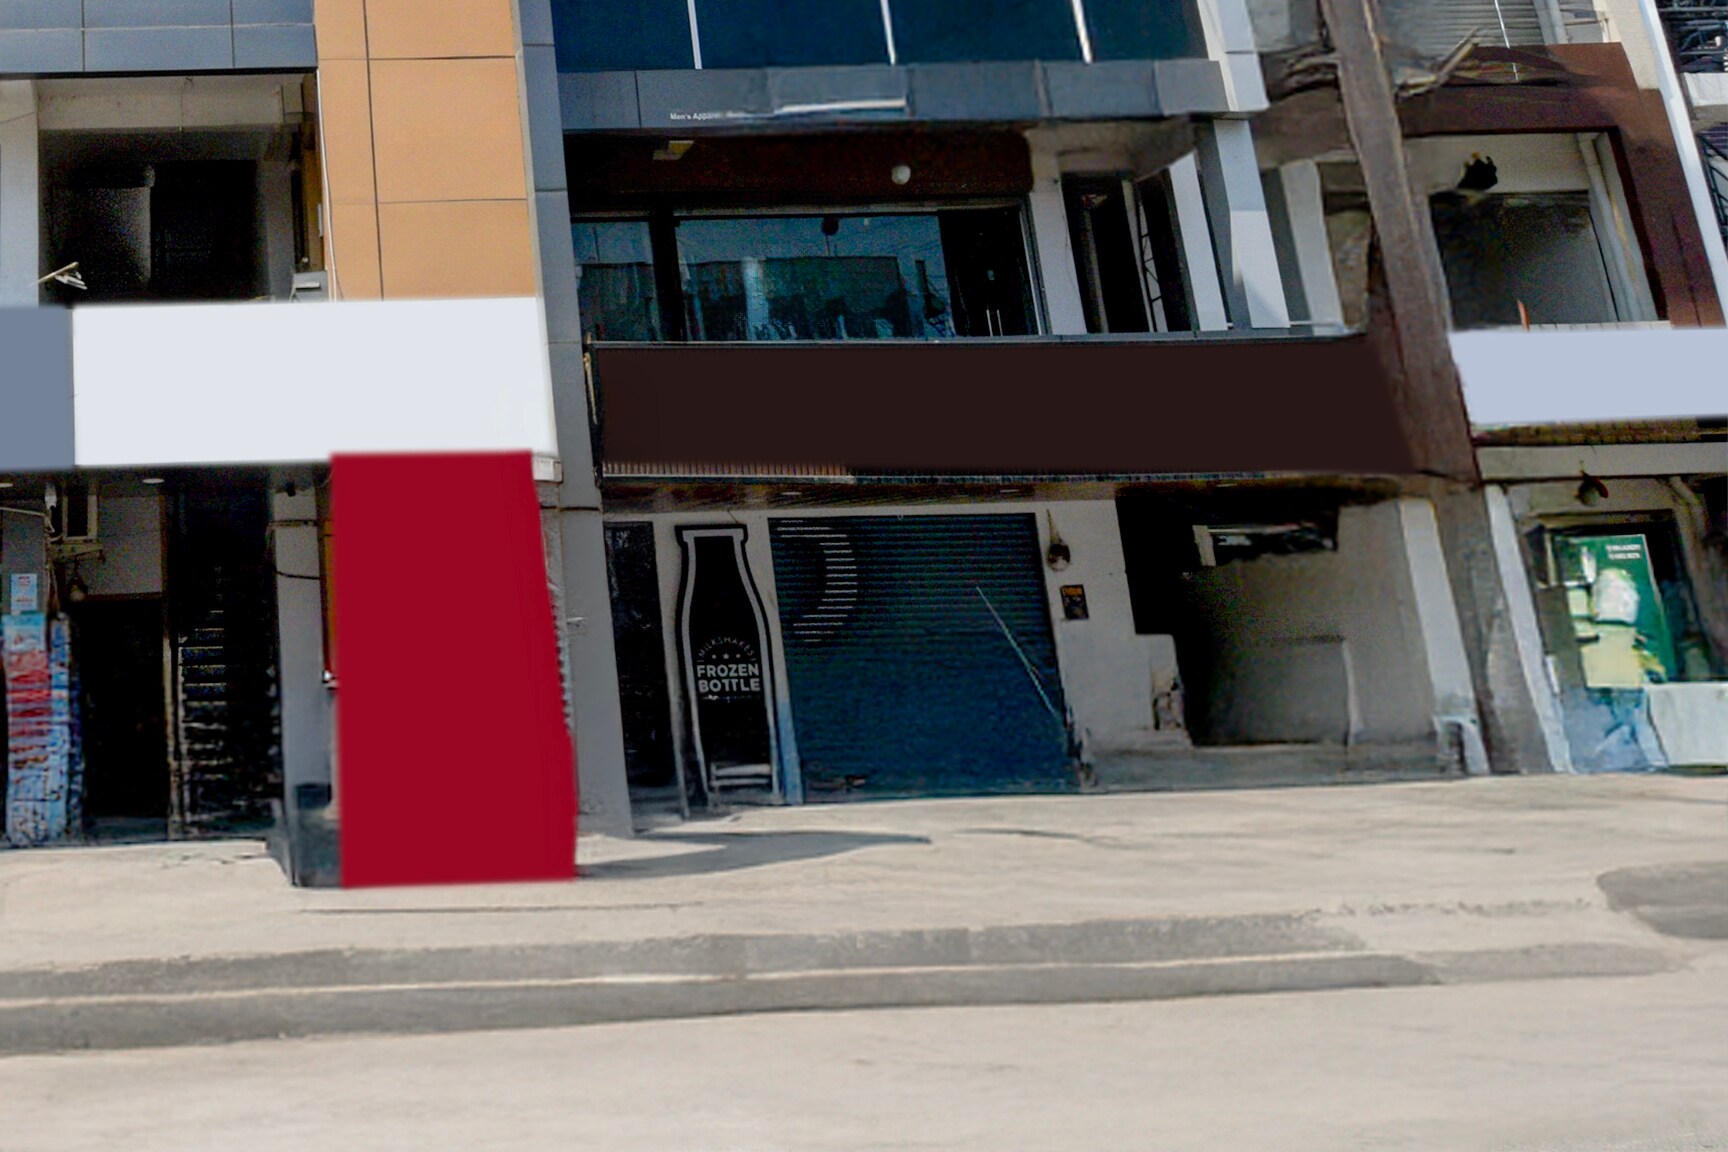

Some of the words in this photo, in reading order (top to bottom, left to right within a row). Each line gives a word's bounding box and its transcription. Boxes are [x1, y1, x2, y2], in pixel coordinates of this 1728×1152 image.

[698, 636, 755, 657] MILKSHAKES
[696, 663, 760, 678] FROZEN
[698, 678, 761, 693] BOTTLE
